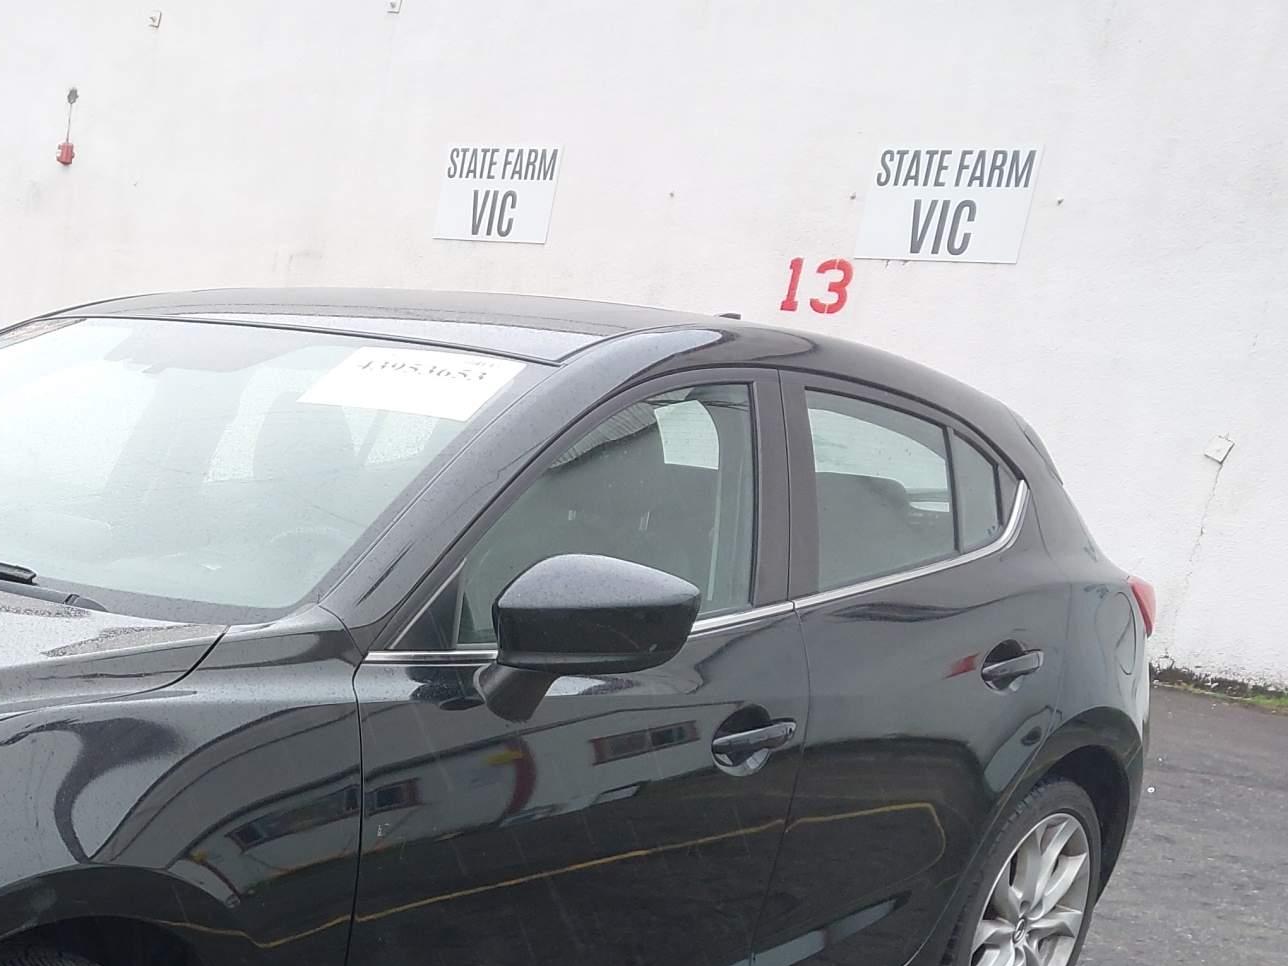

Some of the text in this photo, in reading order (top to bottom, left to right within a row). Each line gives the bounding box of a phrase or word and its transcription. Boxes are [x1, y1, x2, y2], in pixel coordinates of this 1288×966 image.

[447, 147, 558, 181] STATE FARM
[876, 149, 1037, 188] STATE FARM
[471, 189, 518, 238] VIC
[909, 199, 977, 256] VIC
[779, 256, 855, 317] 13
